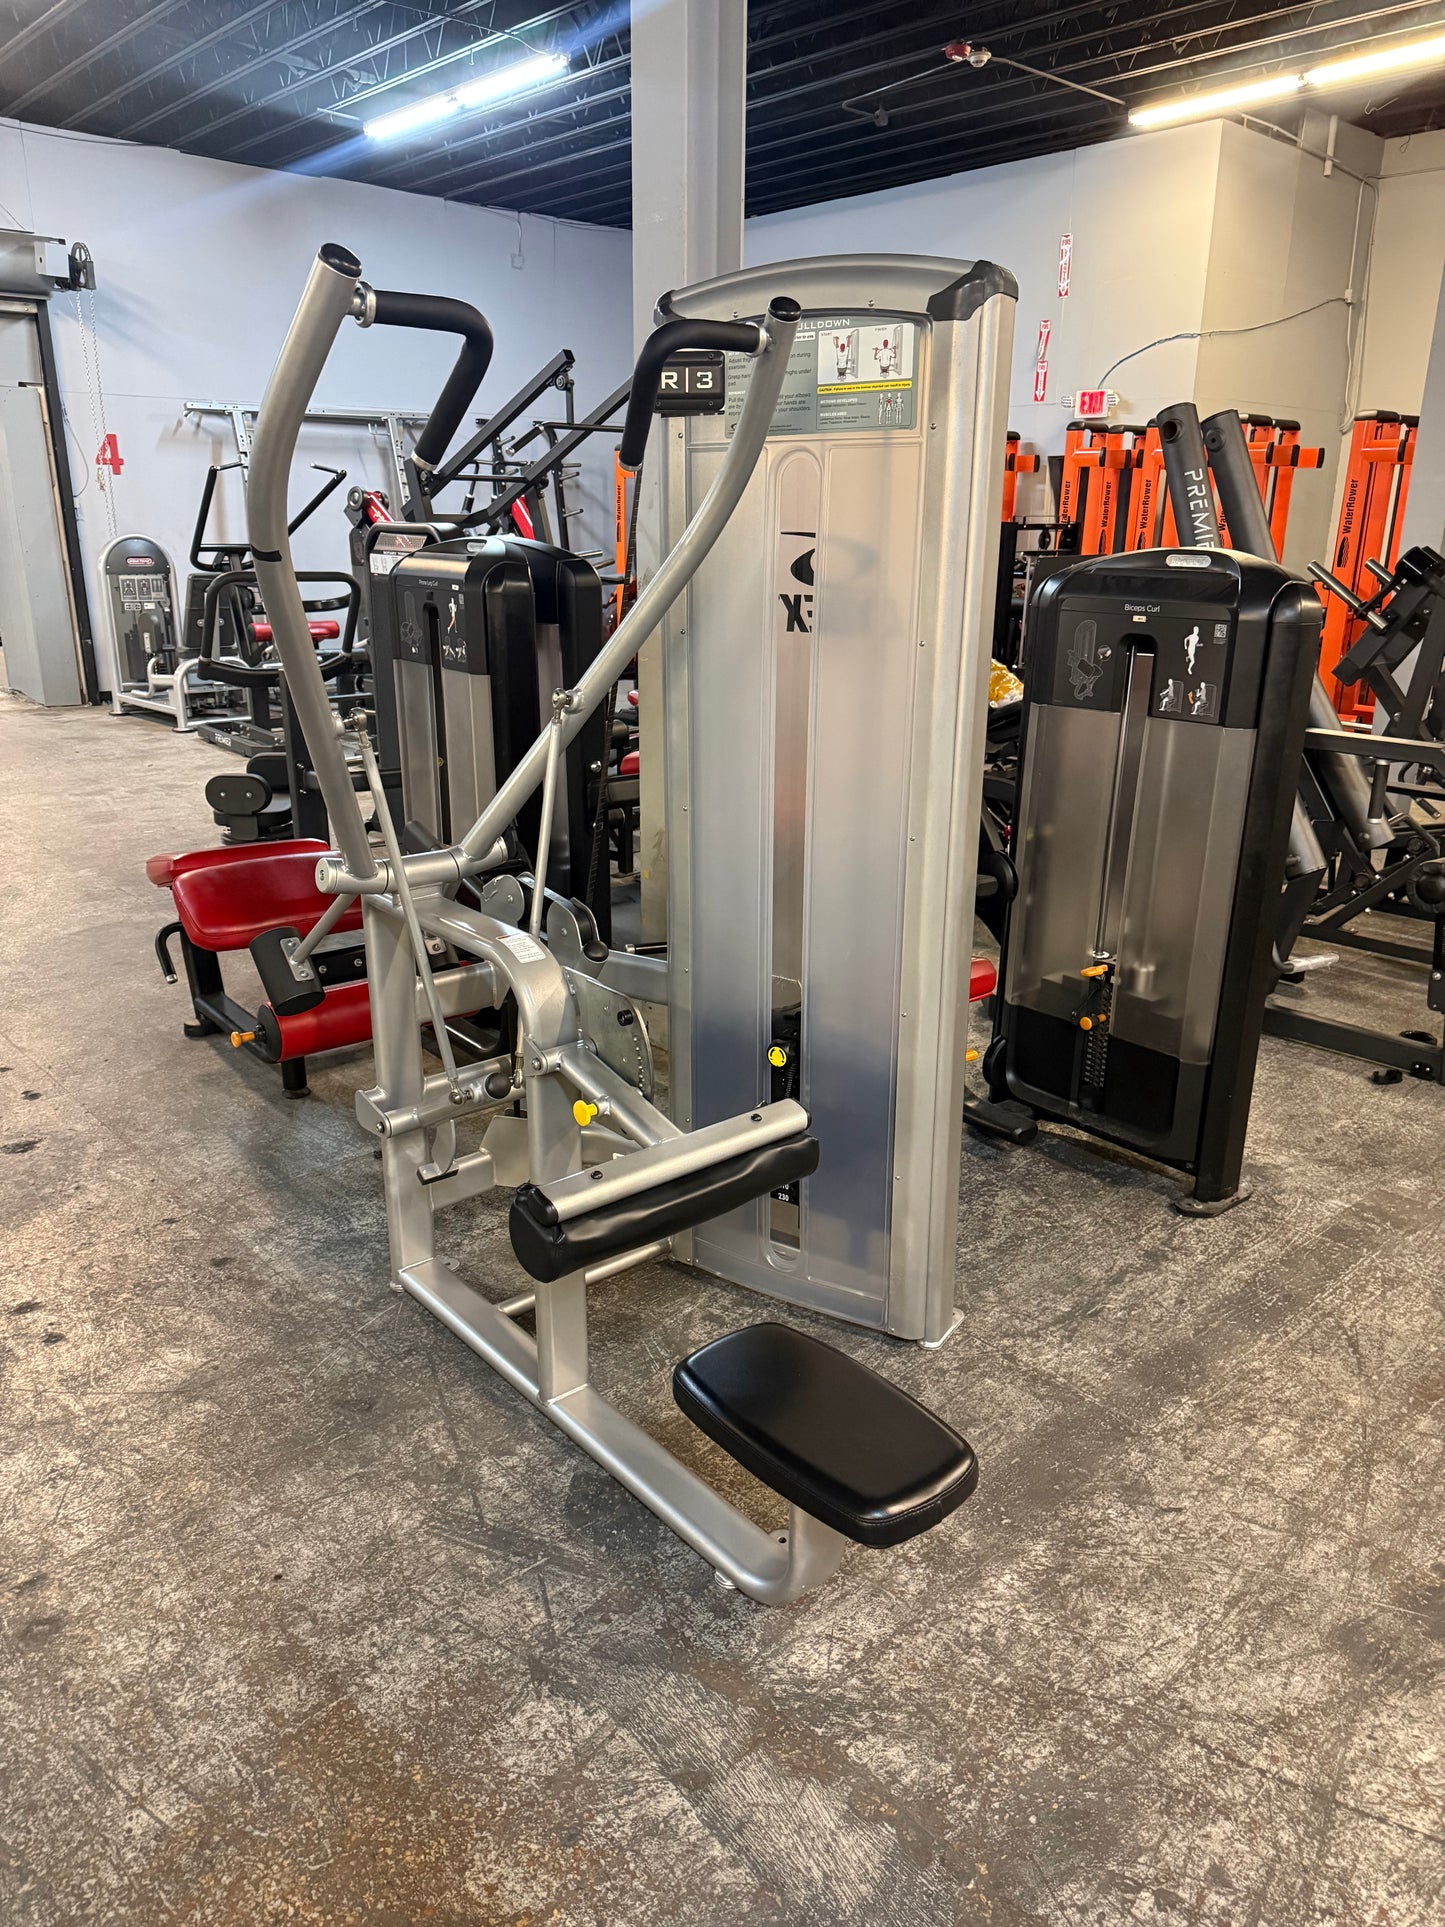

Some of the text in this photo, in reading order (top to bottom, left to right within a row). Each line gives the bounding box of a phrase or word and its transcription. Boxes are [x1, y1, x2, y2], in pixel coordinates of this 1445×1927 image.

[797, 319, 850, 330] ULLDOWN
[96, 434, 124, 475] 4
[1061, 481, 1071, 524] aterRower
[1101, 481, 1112, 528] WaterRower
[1139, 479, 1152, 529] WaterRower
[1342, 479, 1359, 534] WaterRower
[1124, 603, 1160, 612] Biceps Curl
[777, 1192, 790, 1202] 230
